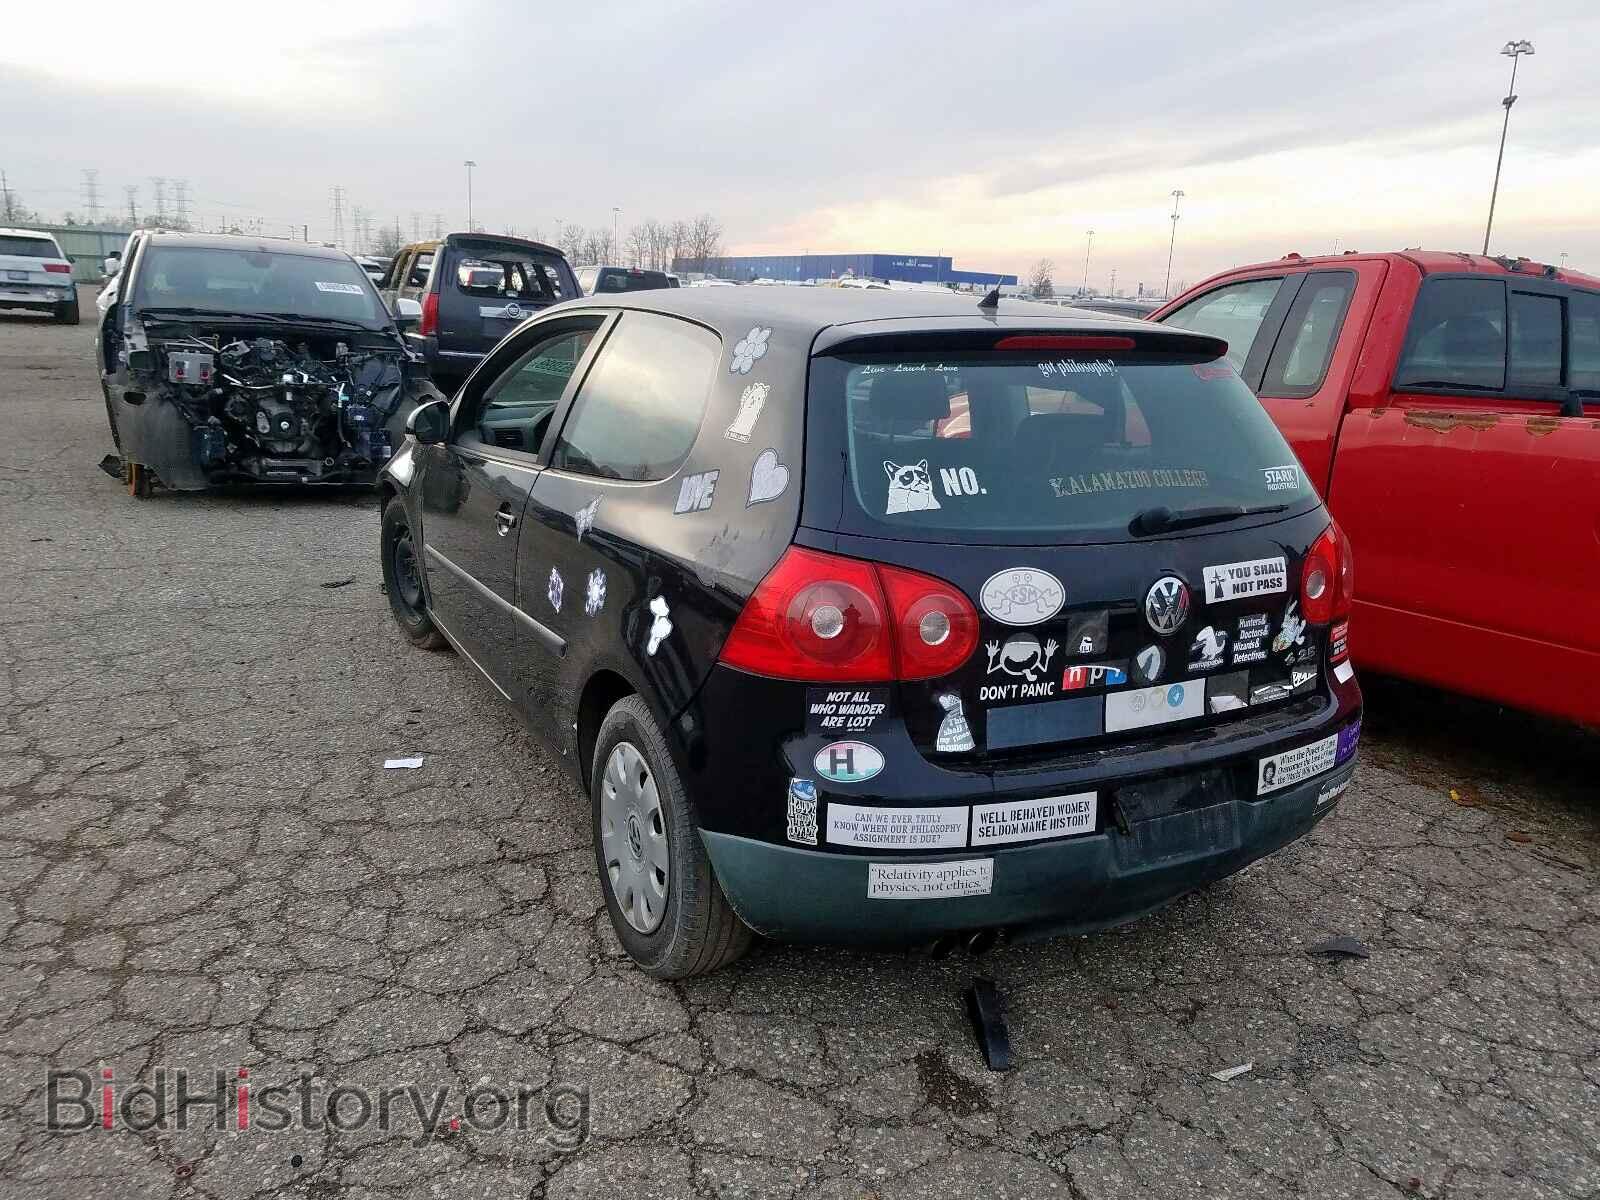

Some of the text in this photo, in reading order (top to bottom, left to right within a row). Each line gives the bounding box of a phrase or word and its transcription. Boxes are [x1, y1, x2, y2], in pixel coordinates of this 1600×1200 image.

[1038, 361, 1057, 377] got
[940, 467, 987, 496] NO.
[1049, 470, 1151, 497] KALAMAZOO
[1264, 469, 1295, 484] STARK
[1228, 562, 1284, 579] YOU SHALL
[1232, 578, 1283, 594] NOT PASS
[826, 691, 870, 702] NOT ALL
[980, 682, 1055, 700] DON'T PANIC
[809, 703, 885, 715] WHO WANDER
[820, 716, 875, 727] ARE LOST
[830, 748, 854, 775] H
[855, 813, 942, 824] CAN WE EVER TRULY
[980, 801, 1090, 824] WELL BEHAVED WOMEN
[834, 820, 962, 833] KNOW WHEN OUR PHILOSOPHY
[978, 813, 1090, 838] SELDOM MAKE HISTORY
[853, 833, 941, 843] ASSIGNMENT IS DUE?
[936, 865, 977, 882] applies
[873, 881, 920, 894] physics,
[923, 881, 943, 892] not
